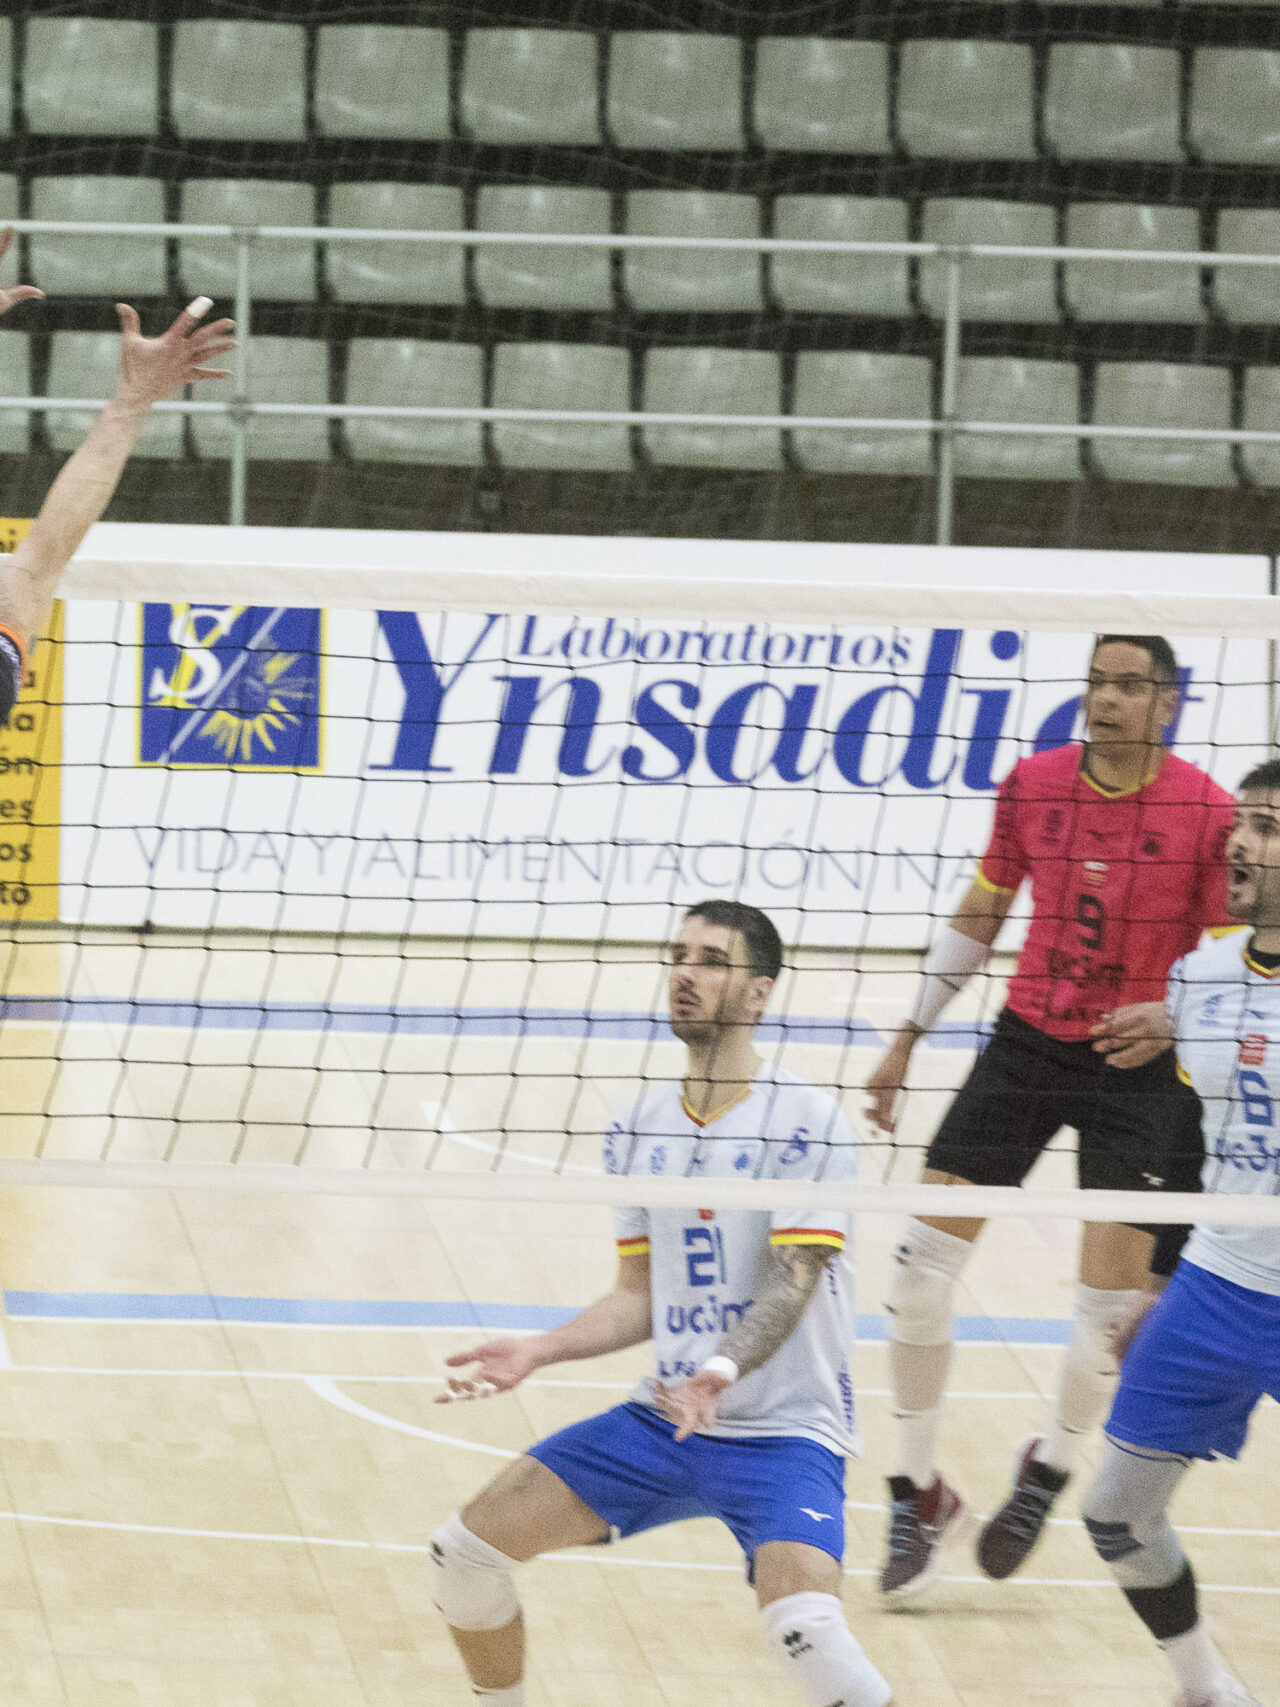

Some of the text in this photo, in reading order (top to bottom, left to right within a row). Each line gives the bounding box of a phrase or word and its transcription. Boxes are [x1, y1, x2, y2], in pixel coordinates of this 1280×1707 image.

[517, 614, 913, 668] Laboratorios
[133, 825, 287, 875] VIDA
[303, 828, 339, 876] Y
[361, 828, 862, 892] ALIMENTACIÓN
